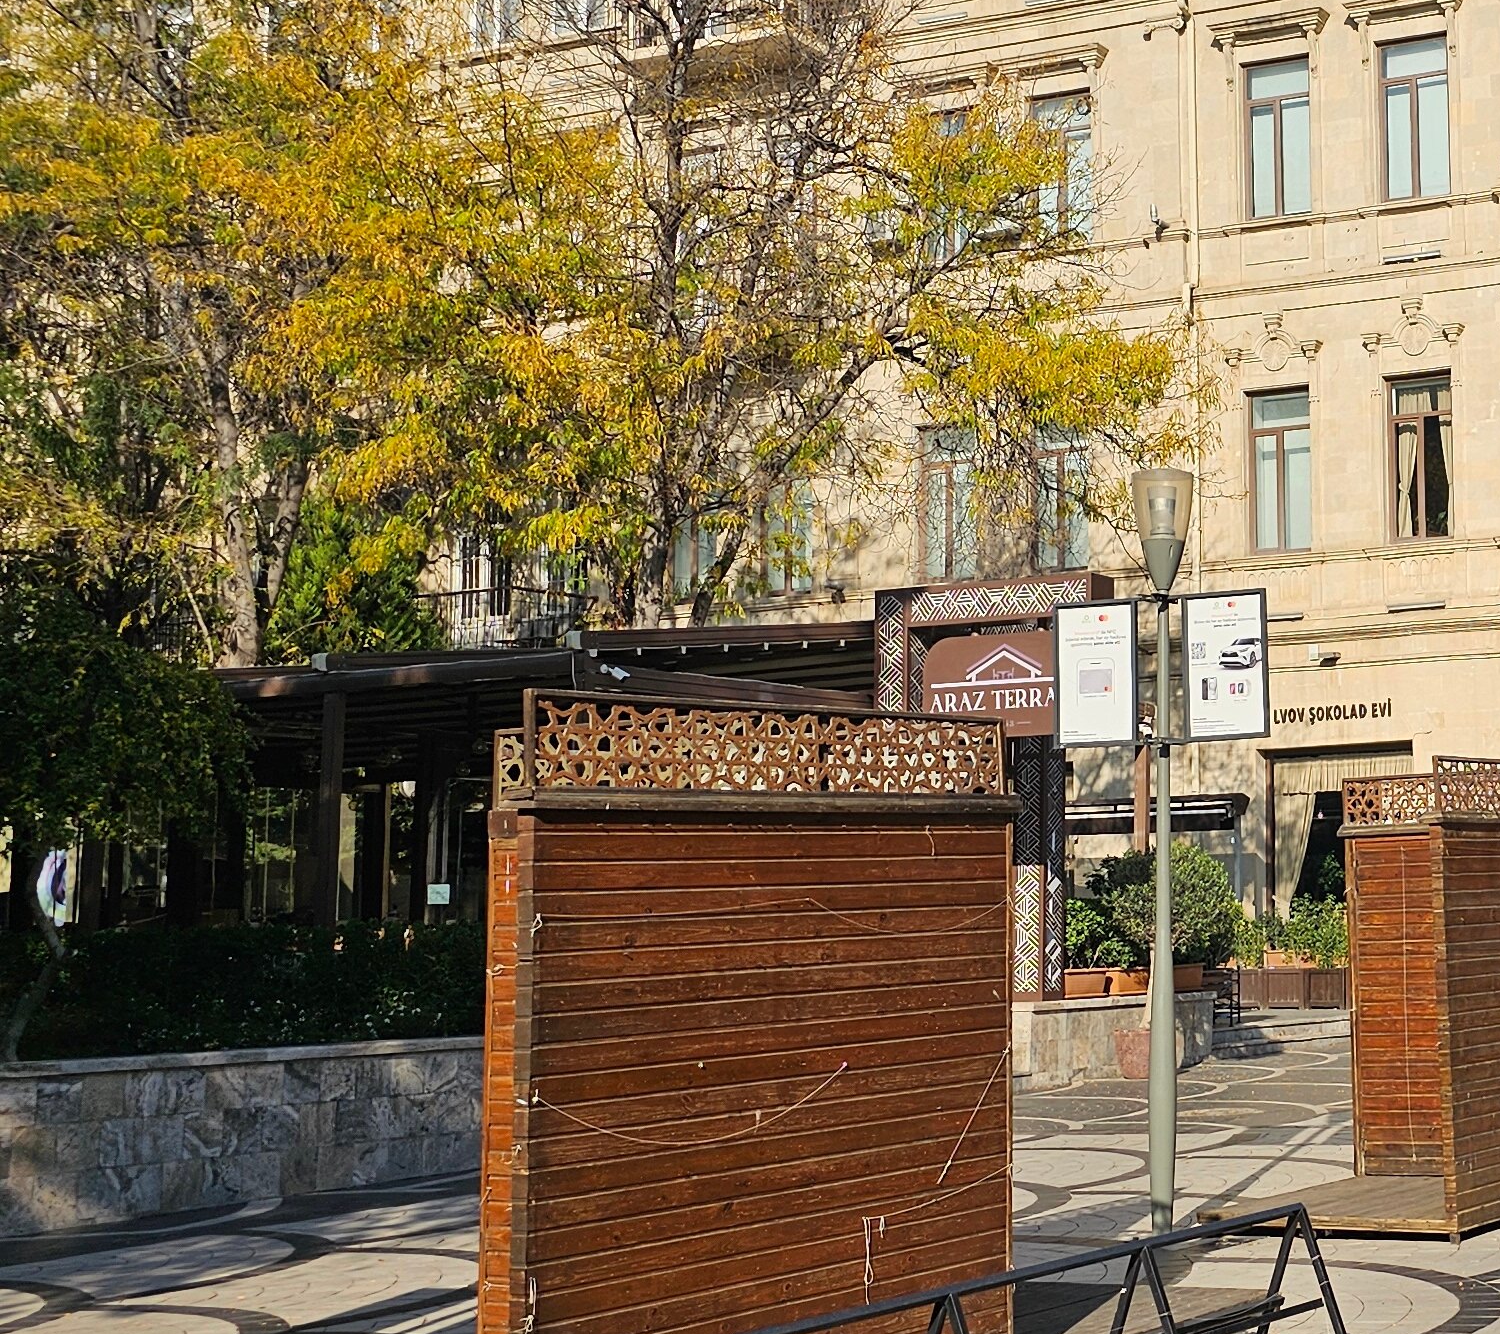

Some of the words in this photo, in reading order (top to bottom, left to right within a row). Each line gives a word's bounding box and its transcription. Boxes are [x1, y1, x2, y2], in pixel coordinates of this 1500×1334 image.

[930, 691, 986, 713] ARAZ
[1273, 707, 1305, 724] LVOV
[1308, 704, 1367, 725] ŞOKOLAD
[1371, 697, 1391, 718] EVİ
